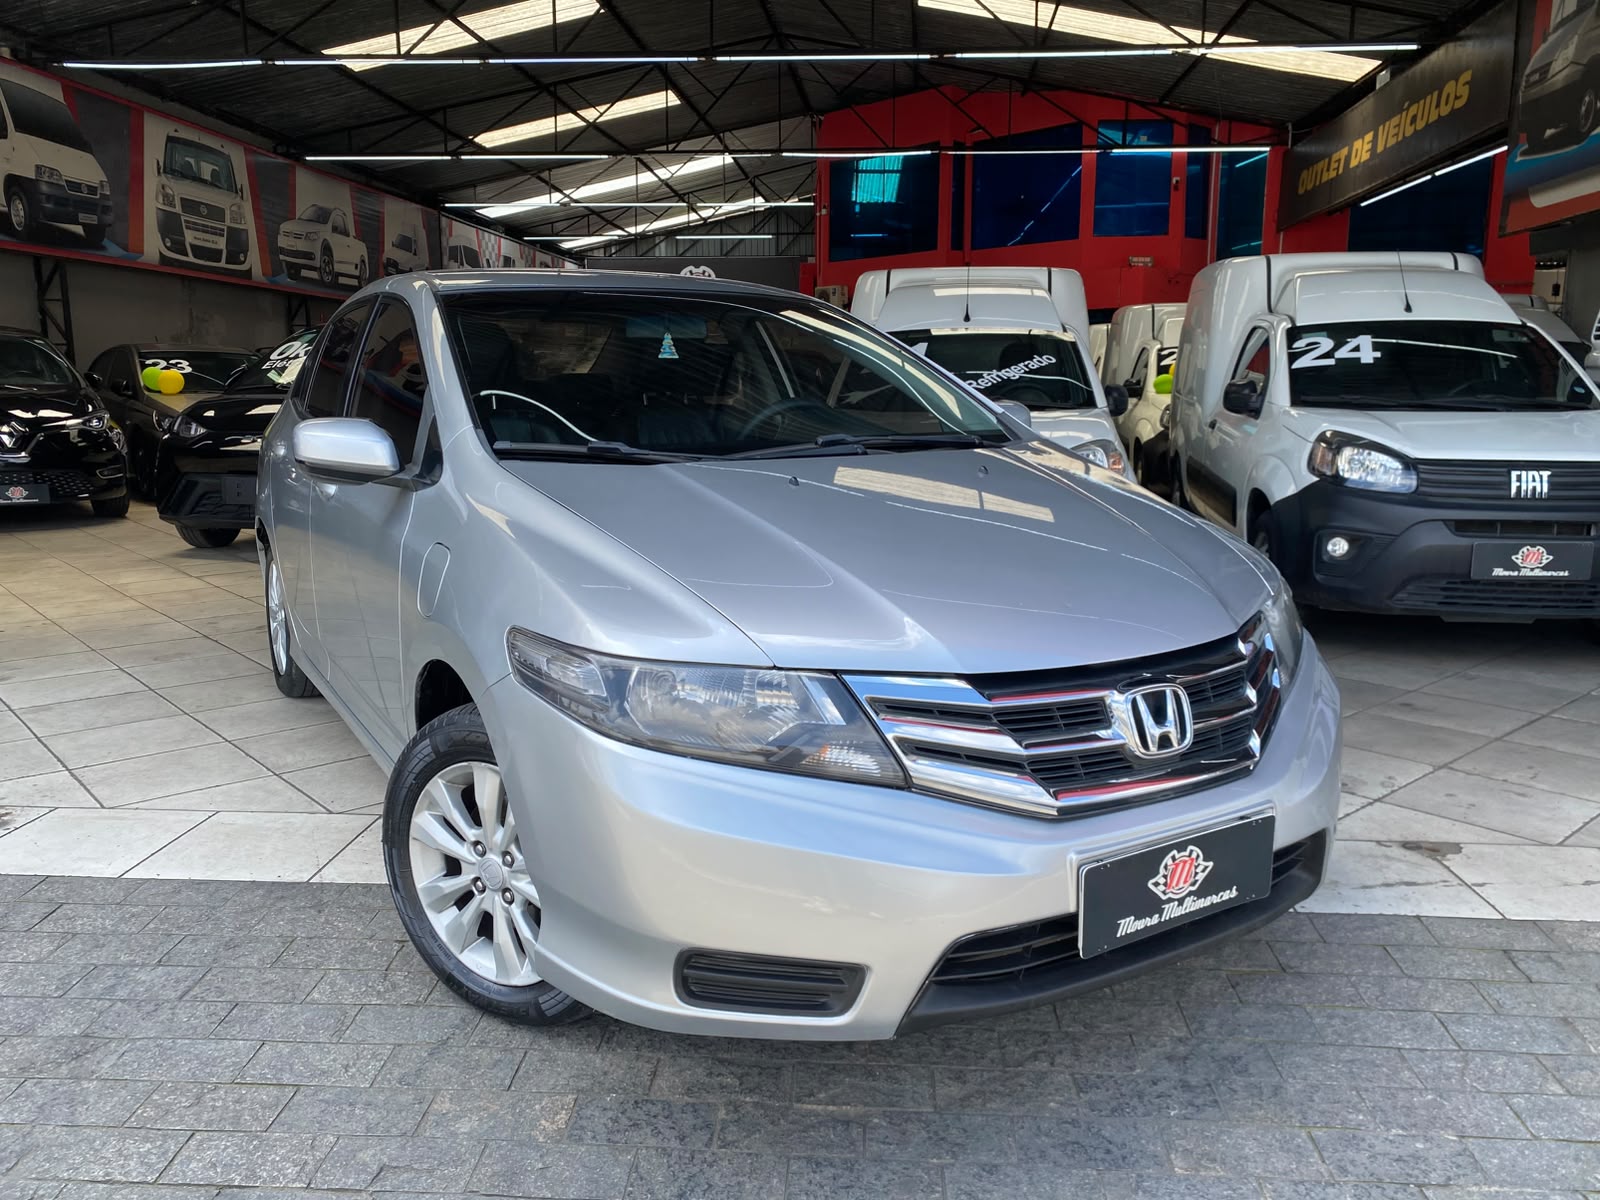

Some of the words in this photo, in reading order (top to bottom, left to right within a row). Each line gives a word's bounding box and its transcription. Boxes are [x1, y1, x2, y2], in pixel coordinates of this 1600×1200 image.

[1298, 146, 1349, 195] OUTLET
[1350, 130, 1374, 169] DE
[1377, 69, 1473, 153] VEÍCULOS
[145, 358, 193, 374] 23
[1291, 334, 1382, 369] 24
[965, 354, 1057, 389] Refrigerado
[1510, 470, 1552, 499] FIAT
[1116, 914, 1161, 938] Moura
[1160, 886, 1239, 921] Multimarcas
